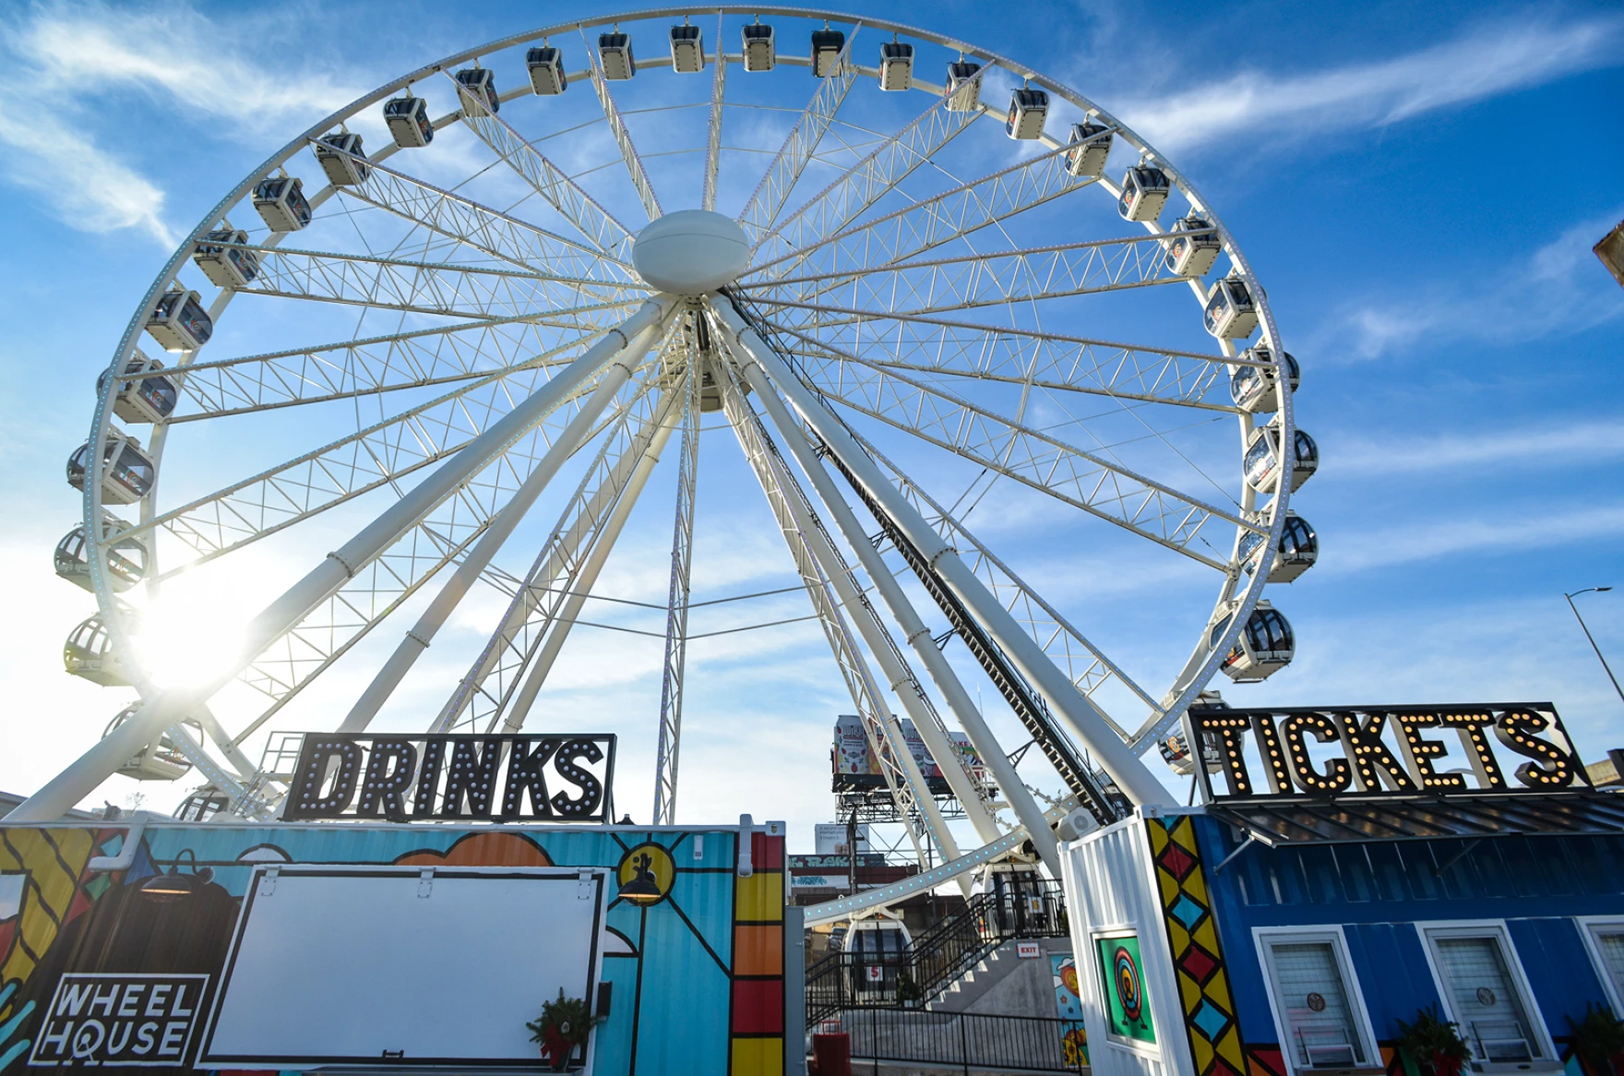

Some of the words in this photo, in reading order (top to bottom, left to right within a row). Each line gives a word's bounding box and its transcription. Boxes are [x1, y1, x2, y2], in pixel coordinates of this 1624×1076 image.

[1200, 708, 1574, 796] TICKETS
[293, 739, 604, 817] DRINKS
[1021, 946, 1037, 954] EXIT
[56, 984, 193, 1017] WHEEL
[40, 1019, 188, 1060] HOUSE
